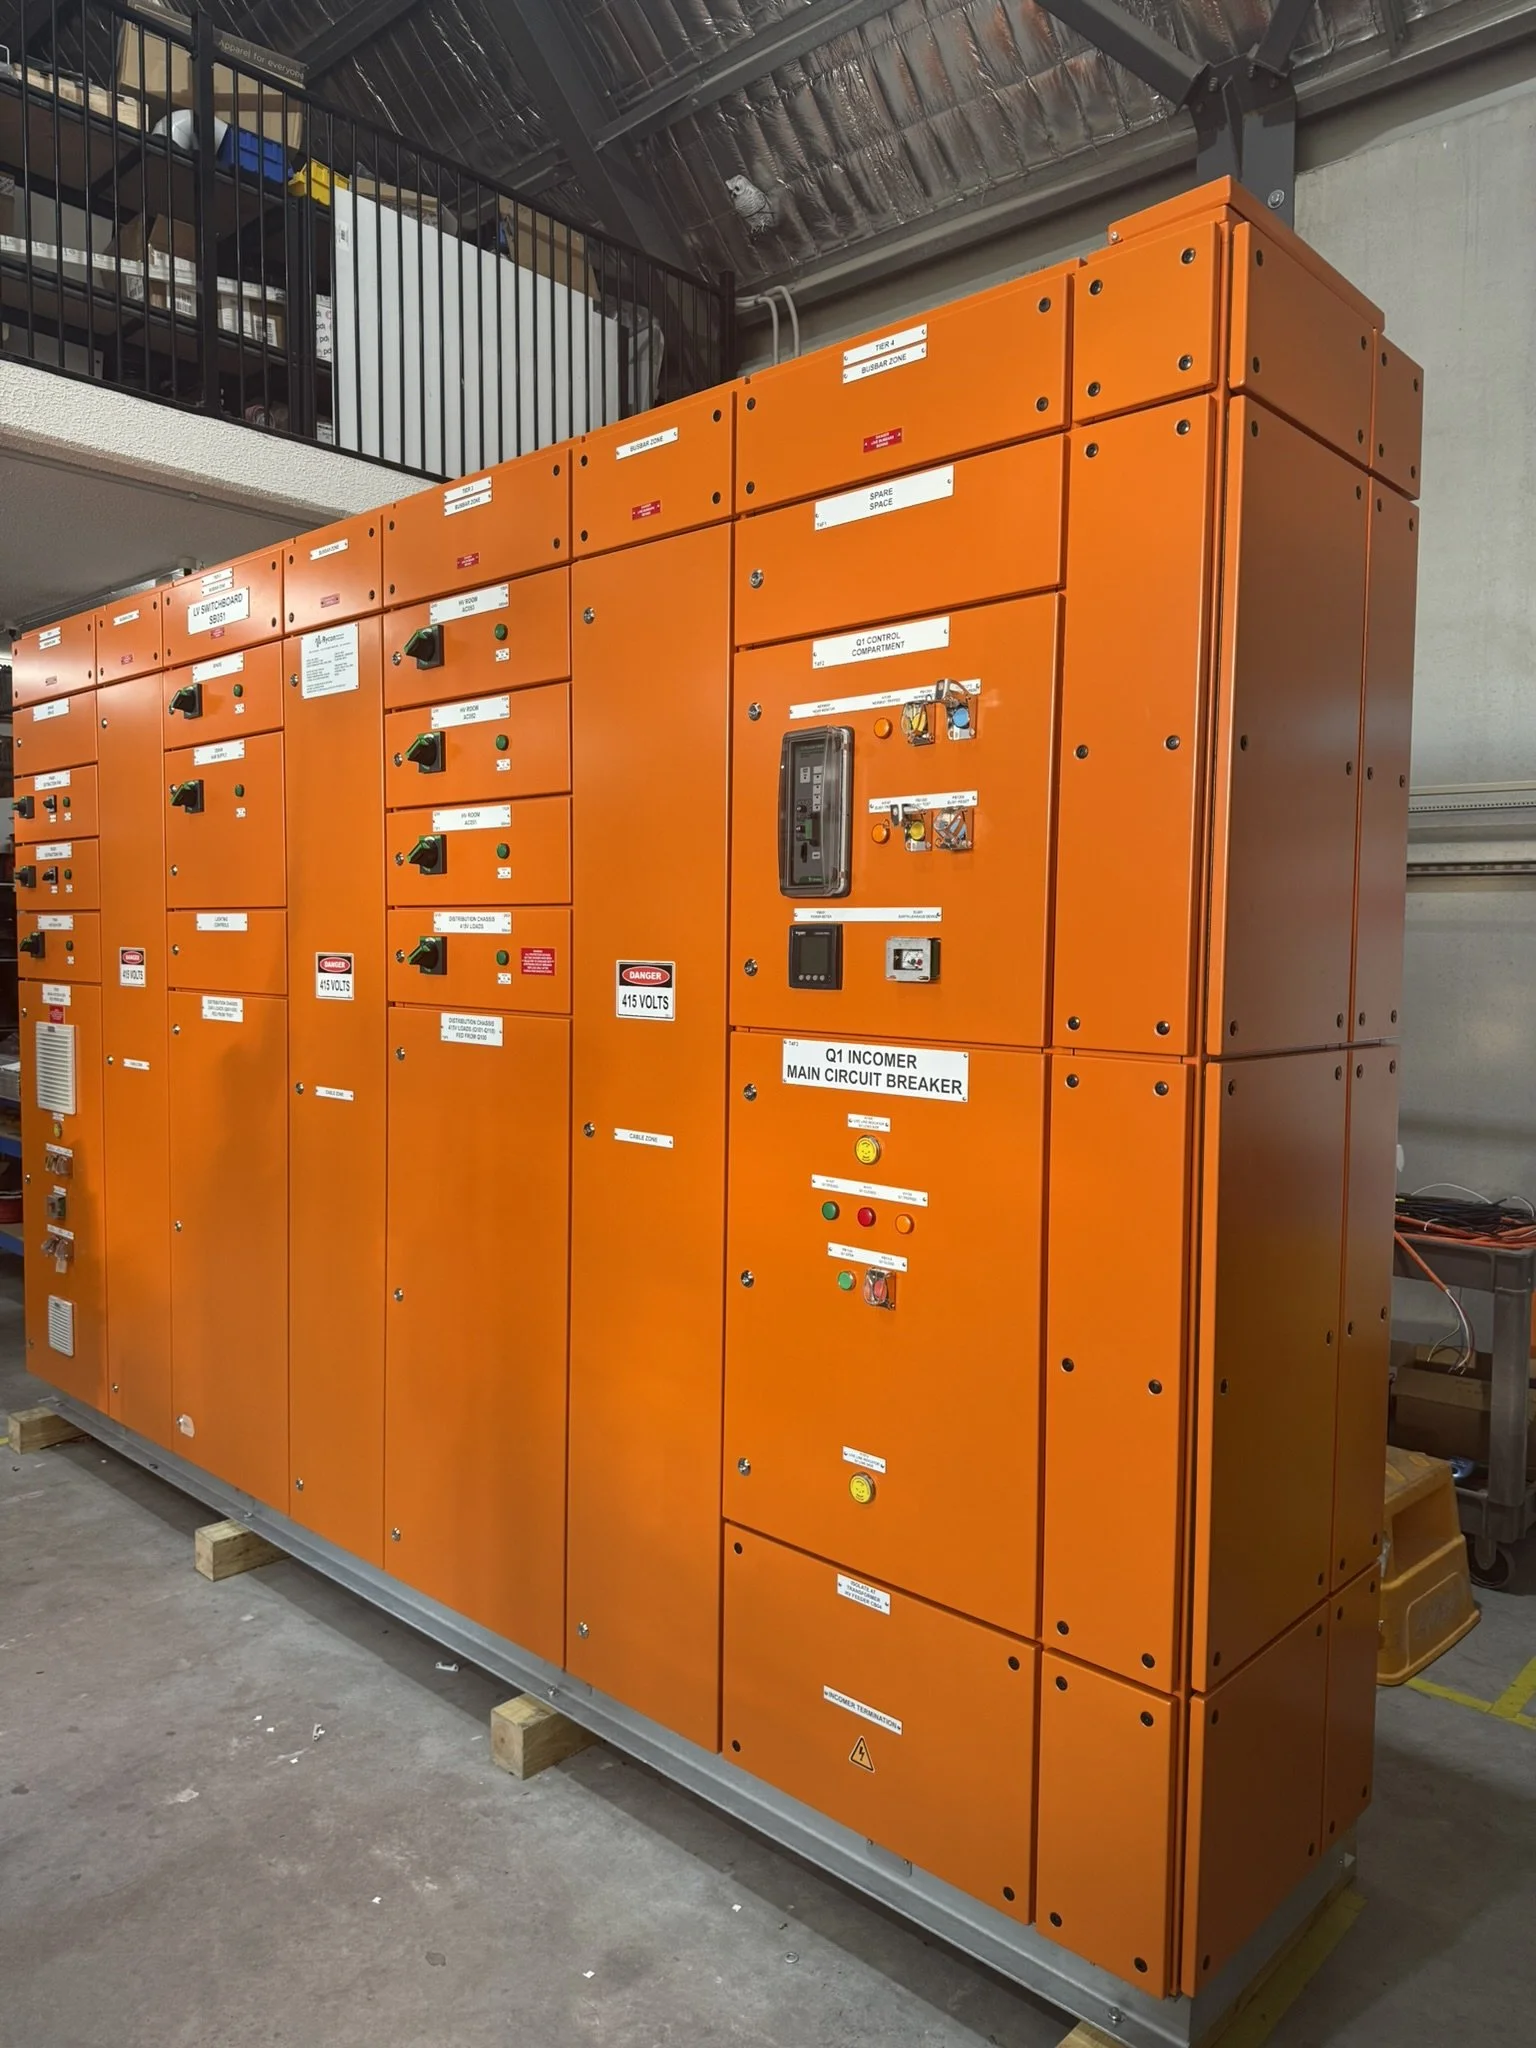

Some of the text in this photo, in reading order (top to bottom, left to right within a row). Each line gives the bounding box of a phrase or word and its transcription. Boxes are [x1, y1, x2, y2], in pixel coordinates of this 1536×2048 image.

[219, 40, 251, 58] Apparel
[253, 53, 265, 63] for
[875, 341, 890, 351] TIER
[861, 353, 907, 374] BUSBAR ZONE
[629, 435, 663, 452] BUSBAR ZONE
[869, 488, 893, 500] SPARE
[869, 498, 893, 510] SPACE
[193, 593, 243, 617] LV SWITCHBOARD
[465, 596, 478, 605] ROOM
[856, 632, 901, 647] Q1 CONTROL
[851, 641, 905, 657] COMPARTMENT
[324, 960, 345, 969] DANGER
[130, 970, 143, 980] VOLTS
[629, 971, 662, 980] DANGER
[320, 979, 350, 992] 415 VOLTS
[622, 993, 669, 1010] 415 VOLTS
[448, 1017, 495, 1027] DISTRIBUTION CHASSIS
[458, 1024, 472, 1032] LOADS
[825, 1048, 917, 1070] Q1 INCOMER
[787, 1064, 962, 1095] MAIN CIRCUIT BREAKER
[629, 1133, 645, 1141] CABLE
[850, 1581, 869, 1593] ISOLATE
[847, 1585, 881, 1602] TRANSFORMER
[852, 1593, 870, 1605] FEEDER
[828, 1691, 897, 1729] INCOMER TERMINATION
